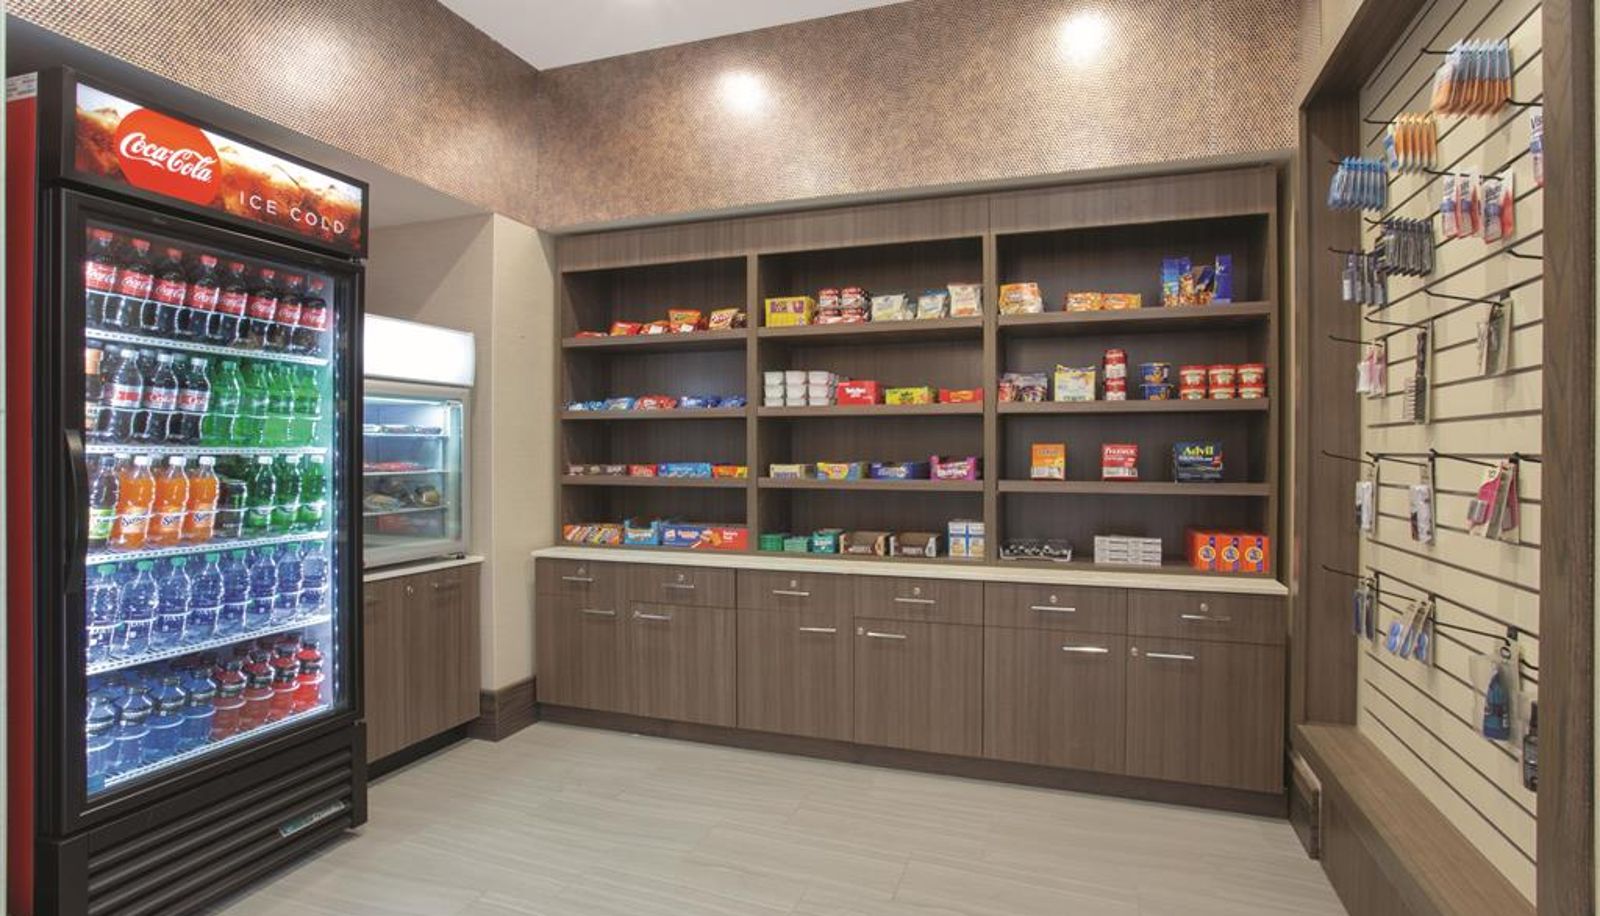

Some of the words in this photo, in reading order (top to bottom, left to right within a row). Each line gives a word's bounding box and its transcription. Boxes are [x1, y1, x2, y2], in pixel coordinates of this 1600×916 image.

[119, 131, 217, 184] Coca-Cola
[240, 190, 277, 216] ICE
[289, 206, 345, 235] COLD
[1183, 445, 1214, 456] Advil
